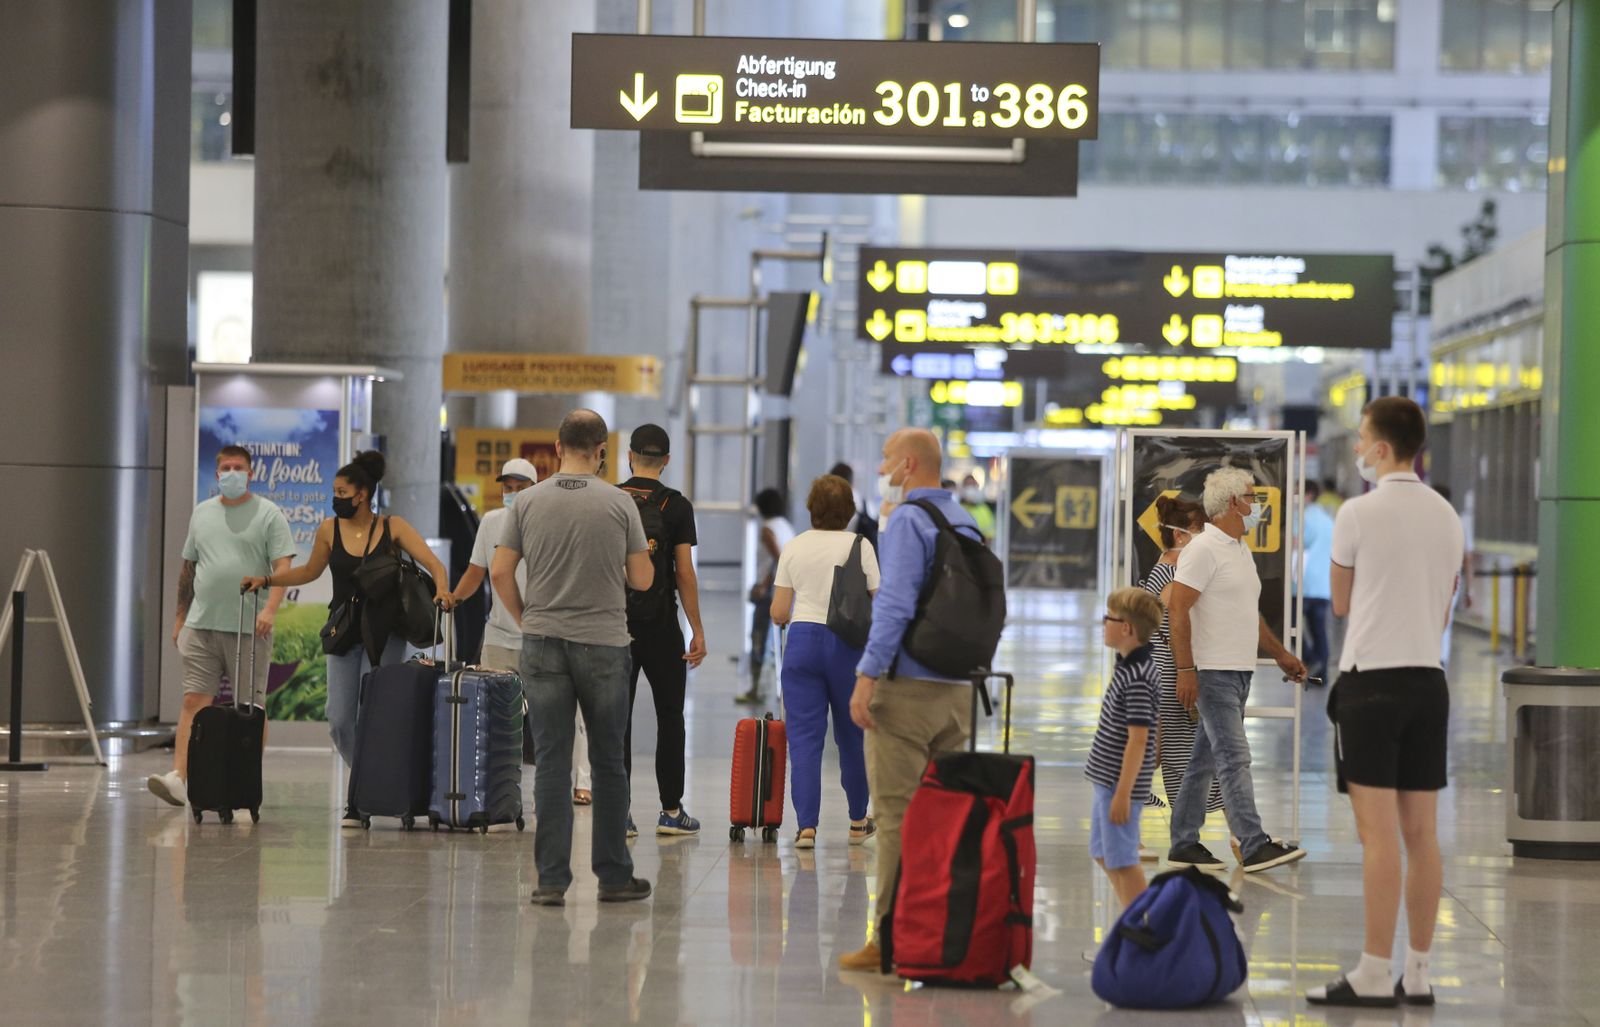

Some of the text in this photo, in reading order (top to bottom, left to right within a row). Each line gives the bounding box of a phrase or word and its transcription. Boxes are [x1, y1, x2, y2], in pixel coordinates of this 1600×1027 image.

[736, 54, 837, 80] Abfertigung
[735, 77, 807, 98] Check-in
[734, 100, 866, 125] Facturación
[872, 80, 1089, 130] 301 to 386
[972, 110, 987, 128] a
